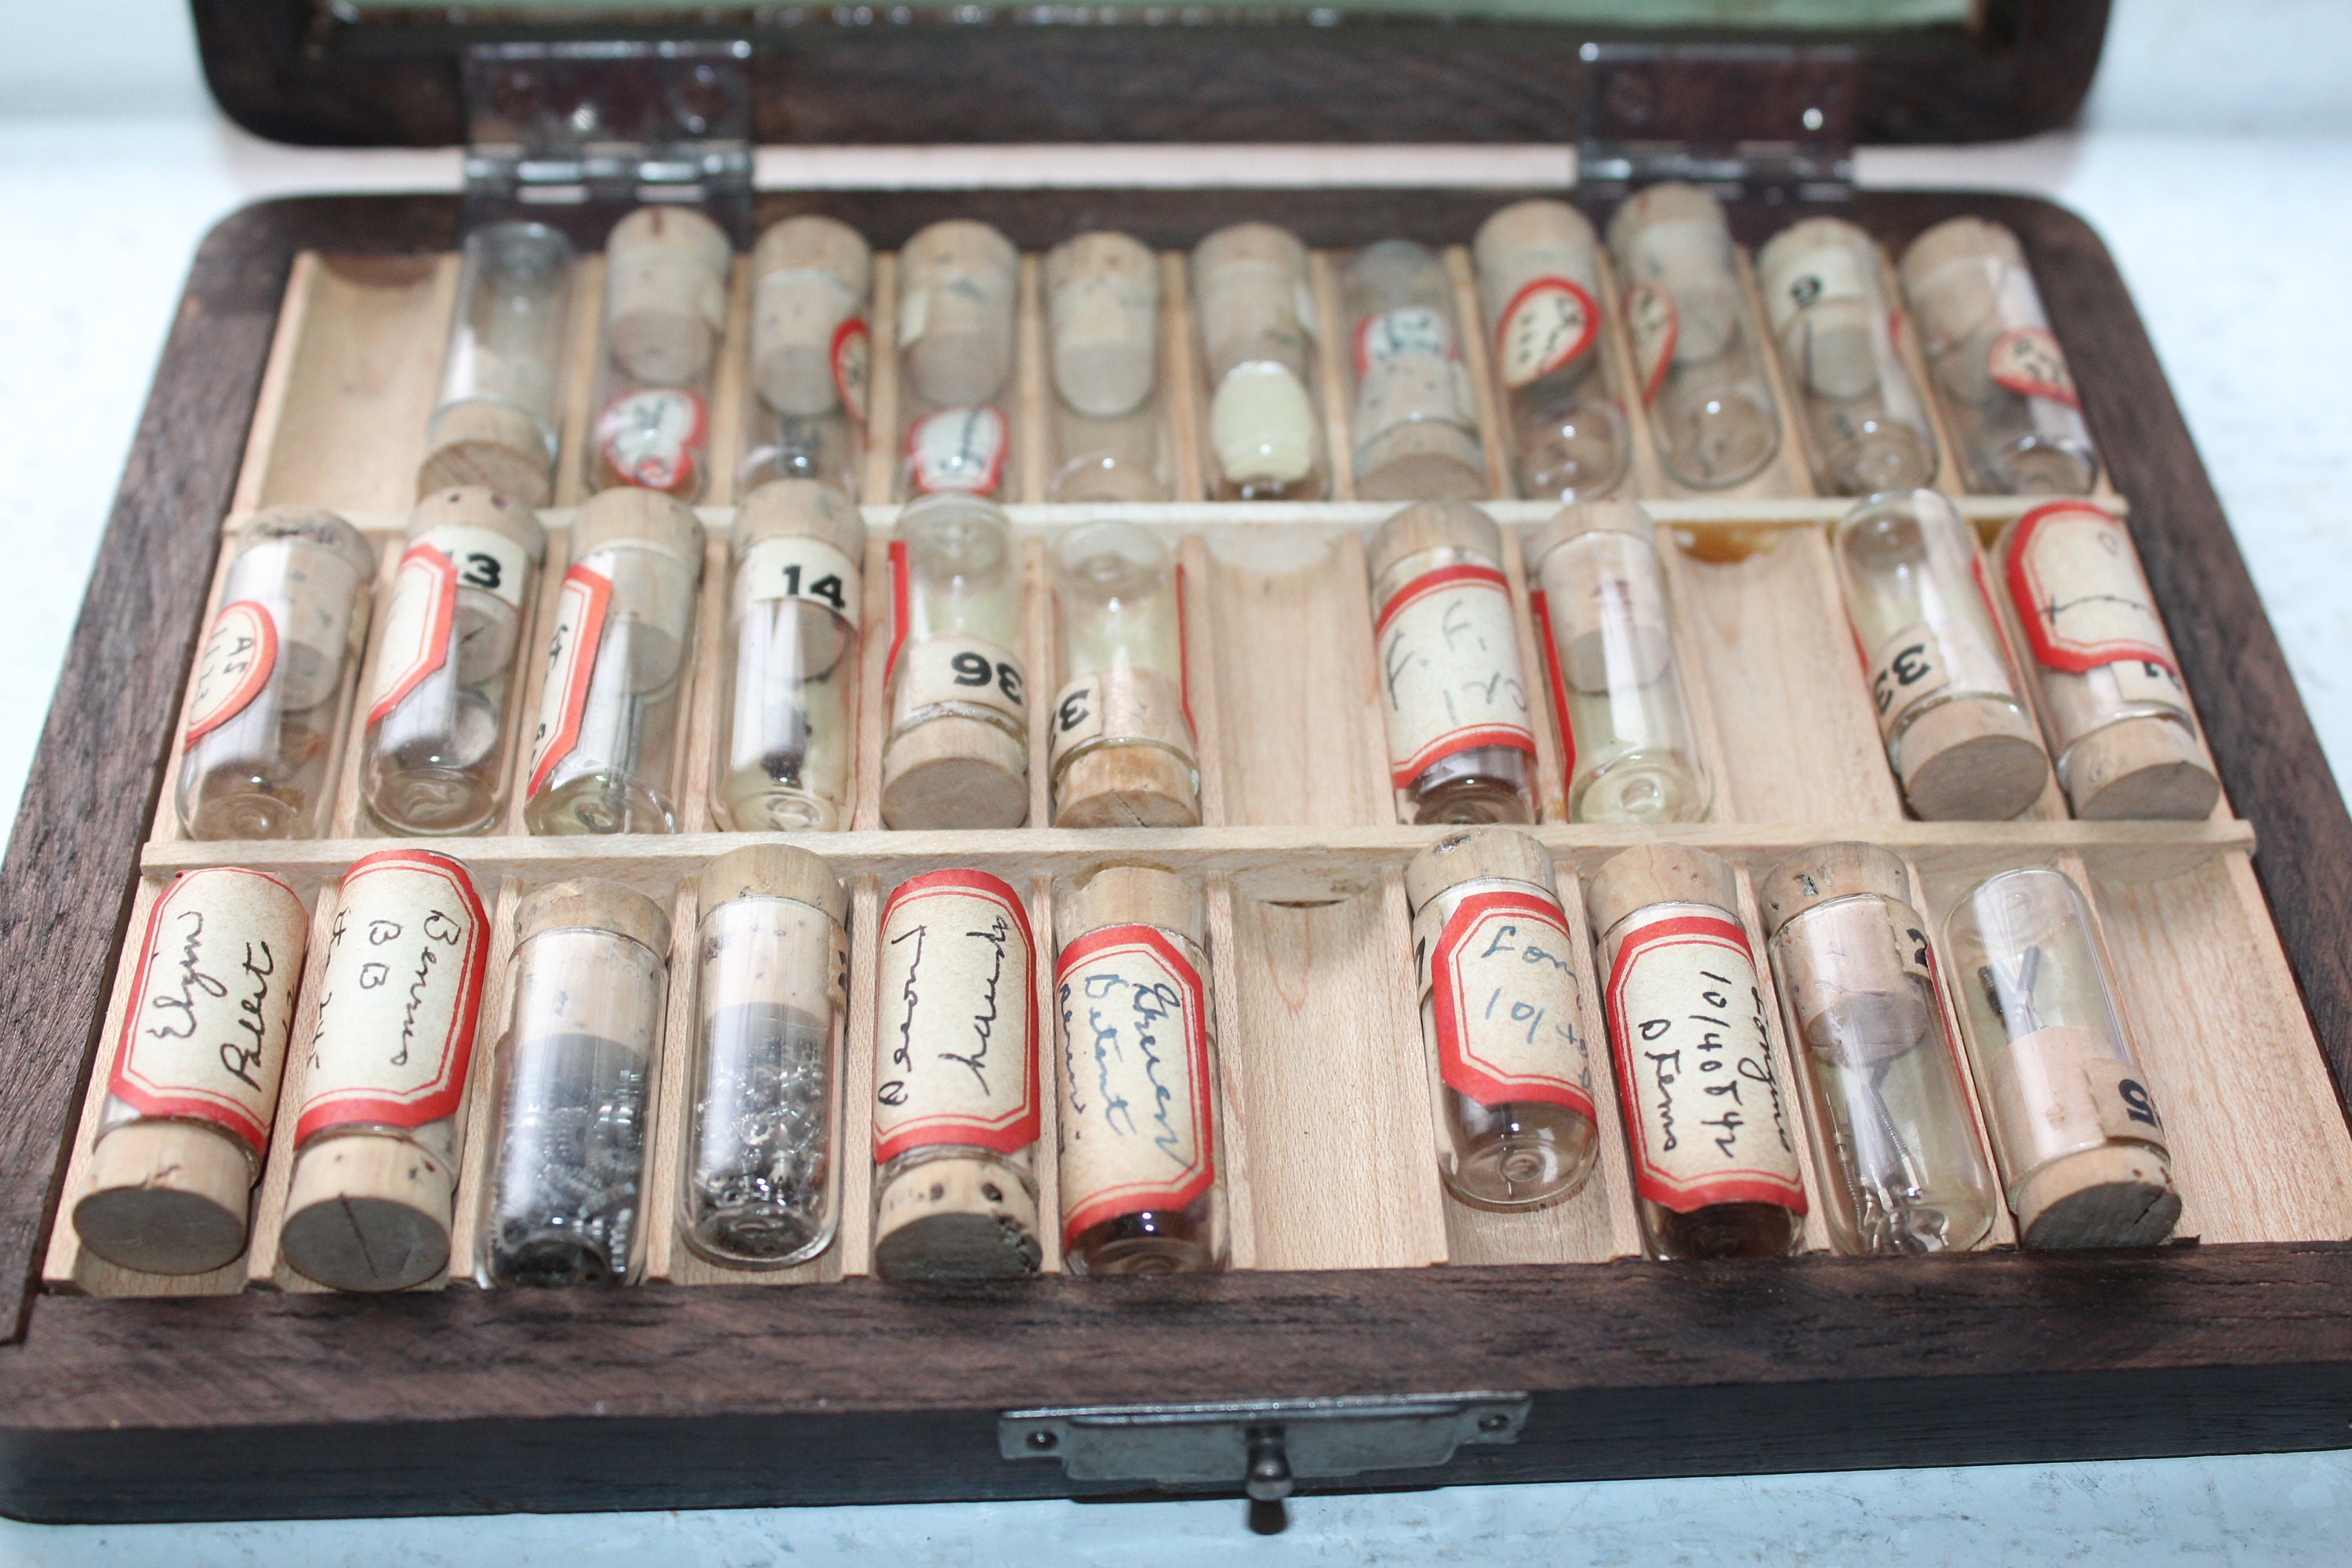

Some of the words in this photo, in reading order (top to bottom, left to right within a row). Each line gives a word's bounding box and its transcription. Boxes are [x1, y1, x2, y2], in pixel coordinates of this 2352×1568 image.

[783, 564, 845, 609] 14
[950, 652, 1023, 706] 36
[390, 909, 460, 1065] Benrus
[2118, 1078, 2158, 1129] 5
